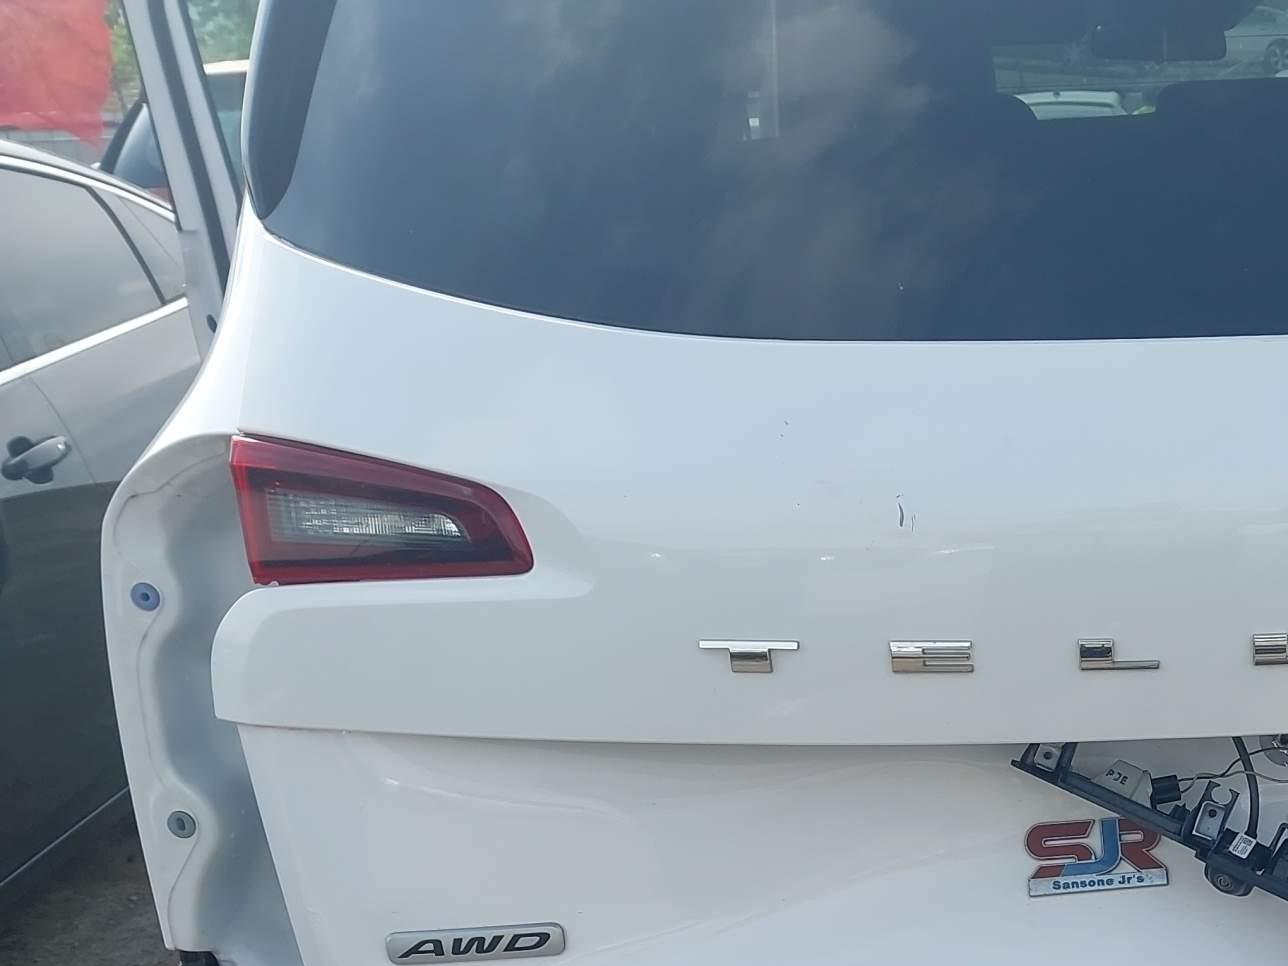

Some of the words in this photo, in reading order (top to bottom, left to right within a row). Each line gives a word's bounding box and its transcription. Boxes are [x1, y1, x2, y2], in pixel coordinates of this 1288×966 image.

[1024, 816, 1168, 878] SJR
[1051, 877, 1115, 890] Sansone
[1117, 874, 1145, 888] Jr's
[397, 931, 551, 959] AWD
